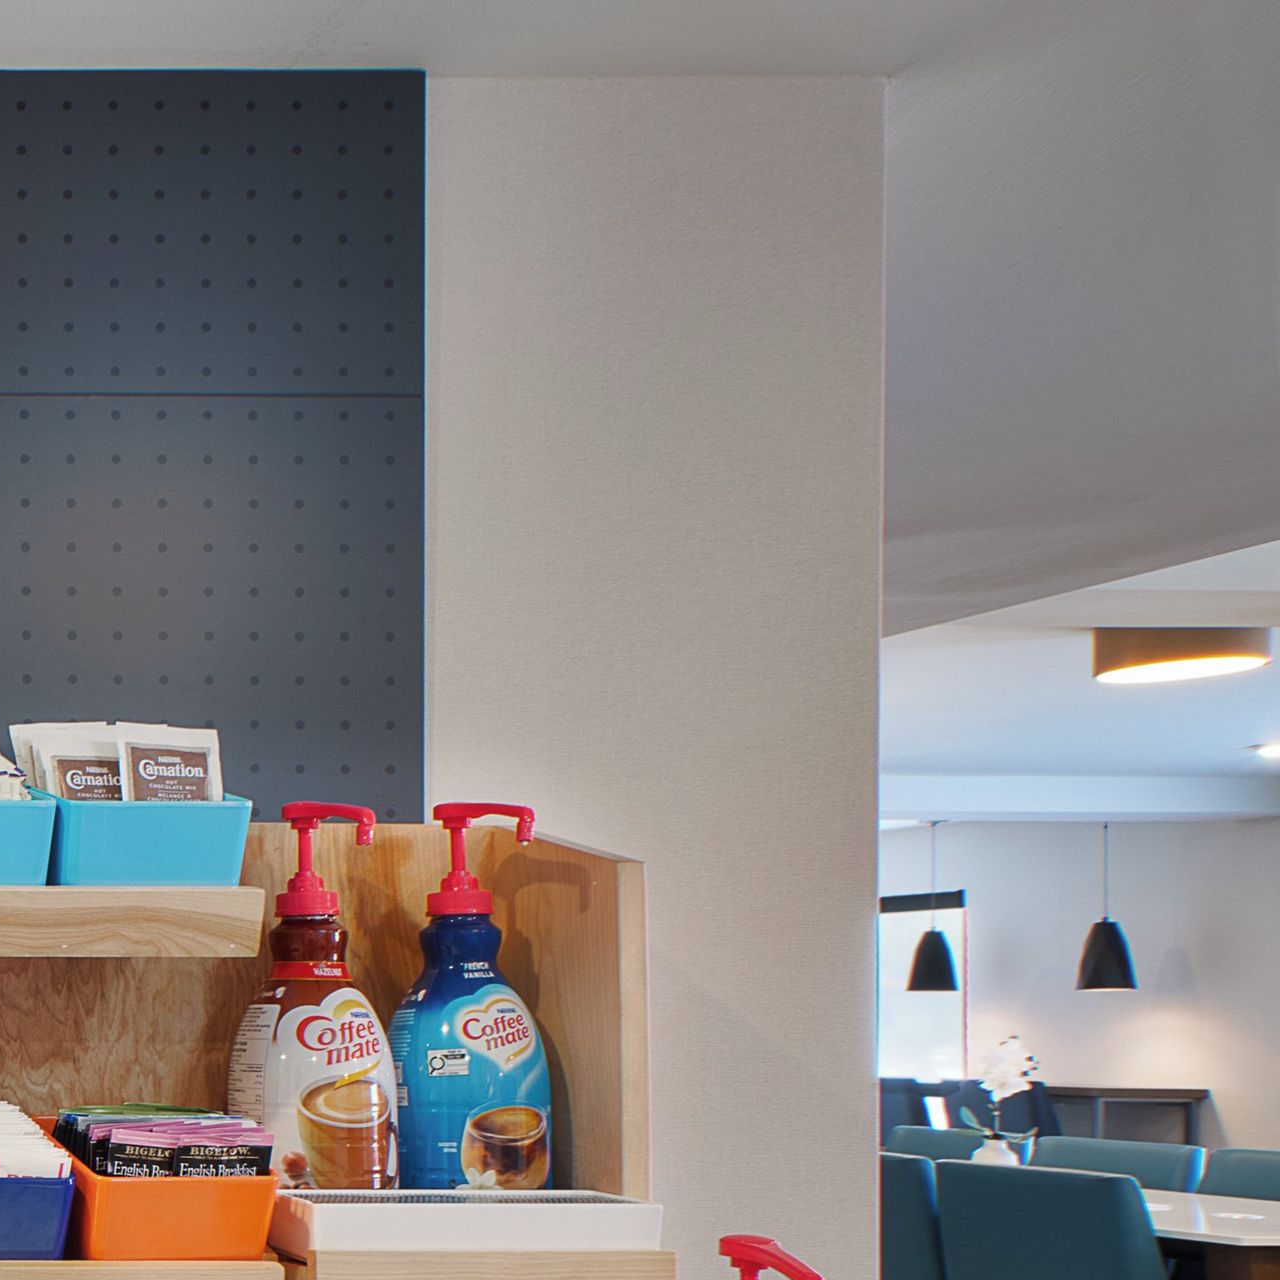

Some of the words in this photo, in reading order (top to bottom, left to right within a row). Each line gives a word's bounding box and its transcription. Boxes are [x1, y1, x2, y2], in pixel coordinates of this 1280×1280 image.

[65, 770, 121, 790] Carnatio
[296, 1016, 376, 1051] Coffee
[462, 1014, 524, 1040] Coffee
[485, 1026, 529, 1051] mate
[326, 1038, 380, 1065] mate
[125, 1146, 173, 1157] BIGELO
[180, 1163, 216, 1177] English
